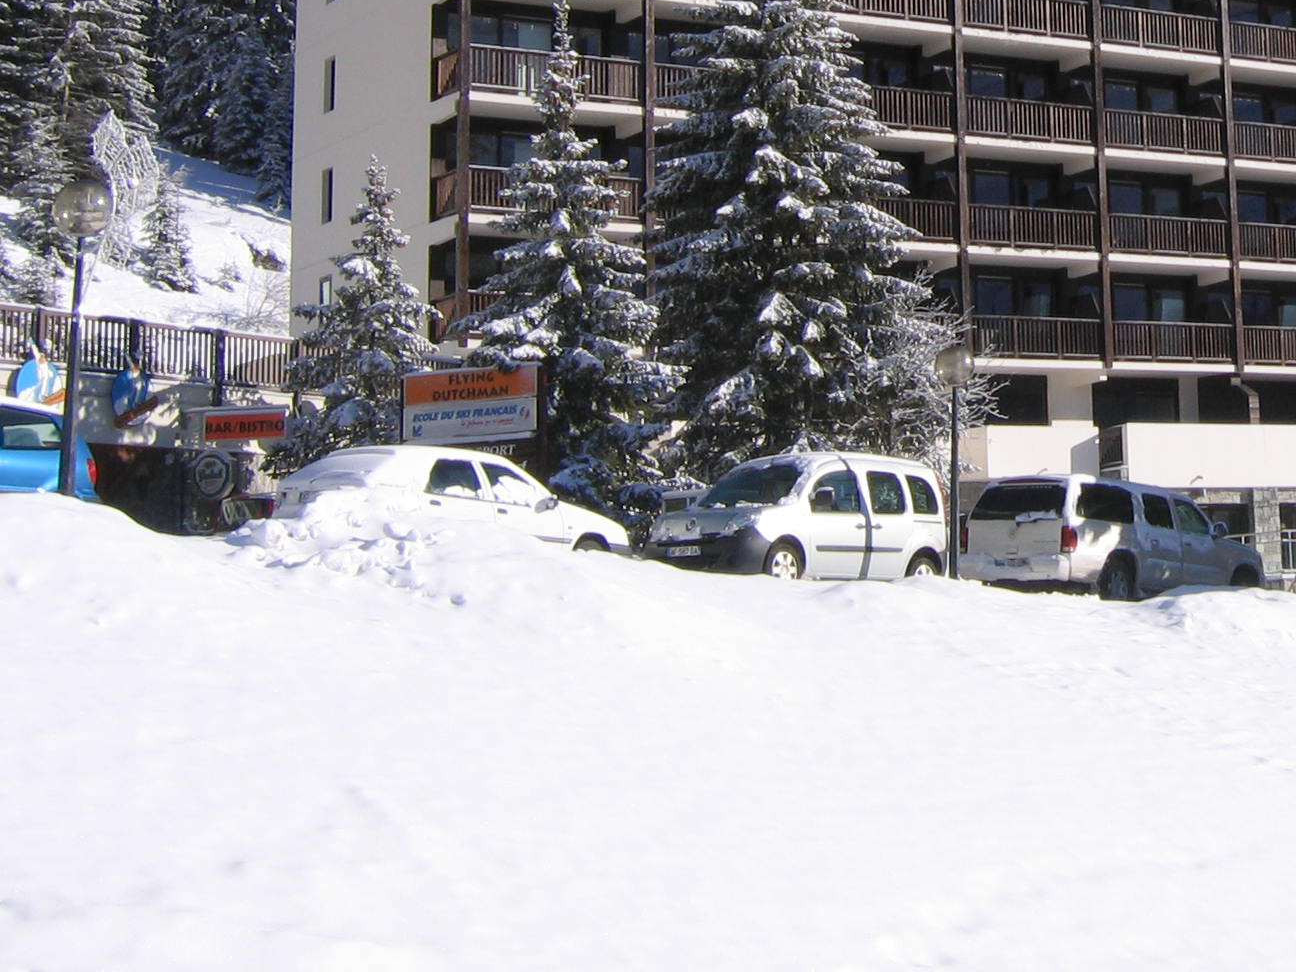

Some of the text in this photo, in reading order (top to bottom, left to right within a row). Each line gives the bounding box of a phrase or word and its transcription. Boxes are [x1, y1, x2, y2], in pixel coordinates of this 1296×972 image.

[448, 371, 494, 385] FLYING
[433, 386, 508, 401] DUTCHMAN
[413, 412, 440, 422] ECOLE
[441, 411, 454, 420] DU
[455, 410, 471, 419] SKI
